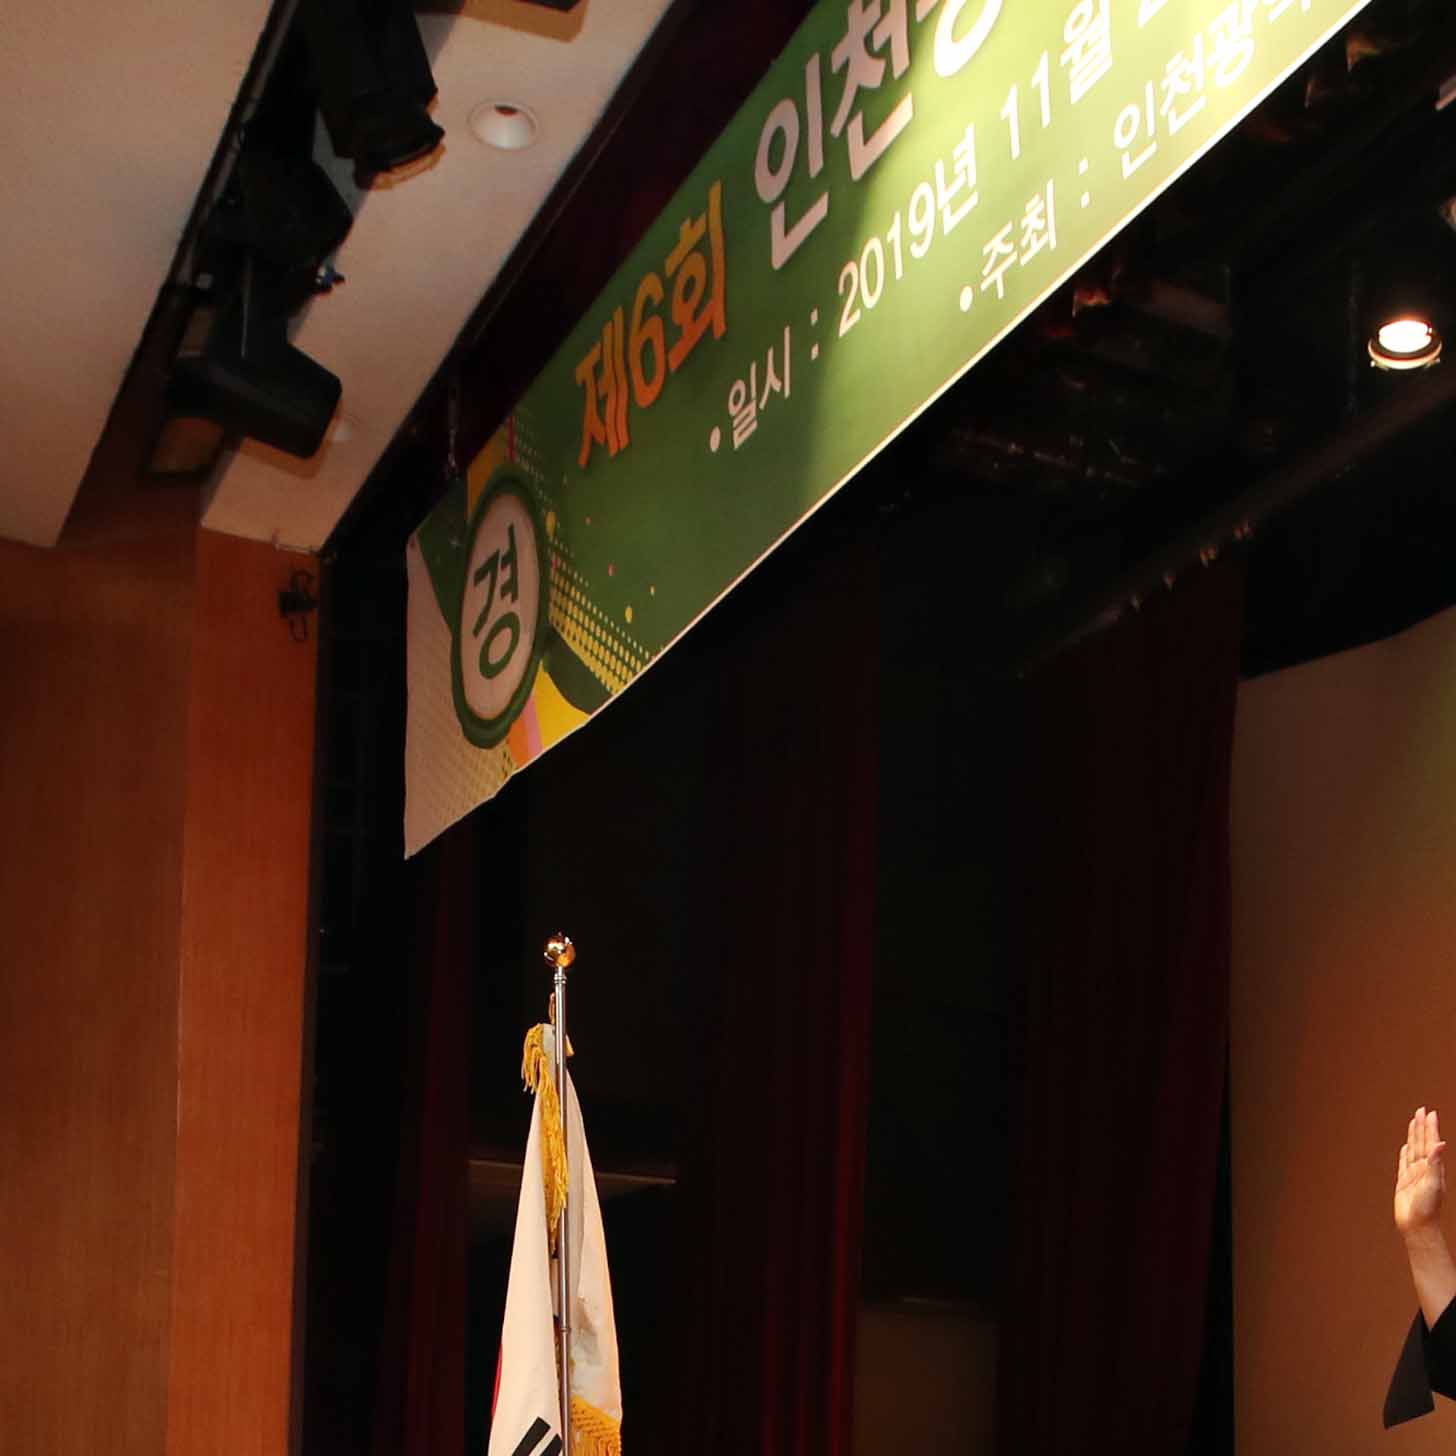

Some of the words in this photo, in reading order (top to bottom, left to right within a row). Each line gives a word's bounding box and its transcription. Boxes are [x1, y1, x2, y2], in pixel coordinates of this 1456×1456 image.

[574, 182, 727, 470] 제6회
[726, 326, 792, 452] 일시
[837, 122, 980, 336] 2019년
[979, 179, 1058, 302] 주최
[473, 522, 520, 679] 경
